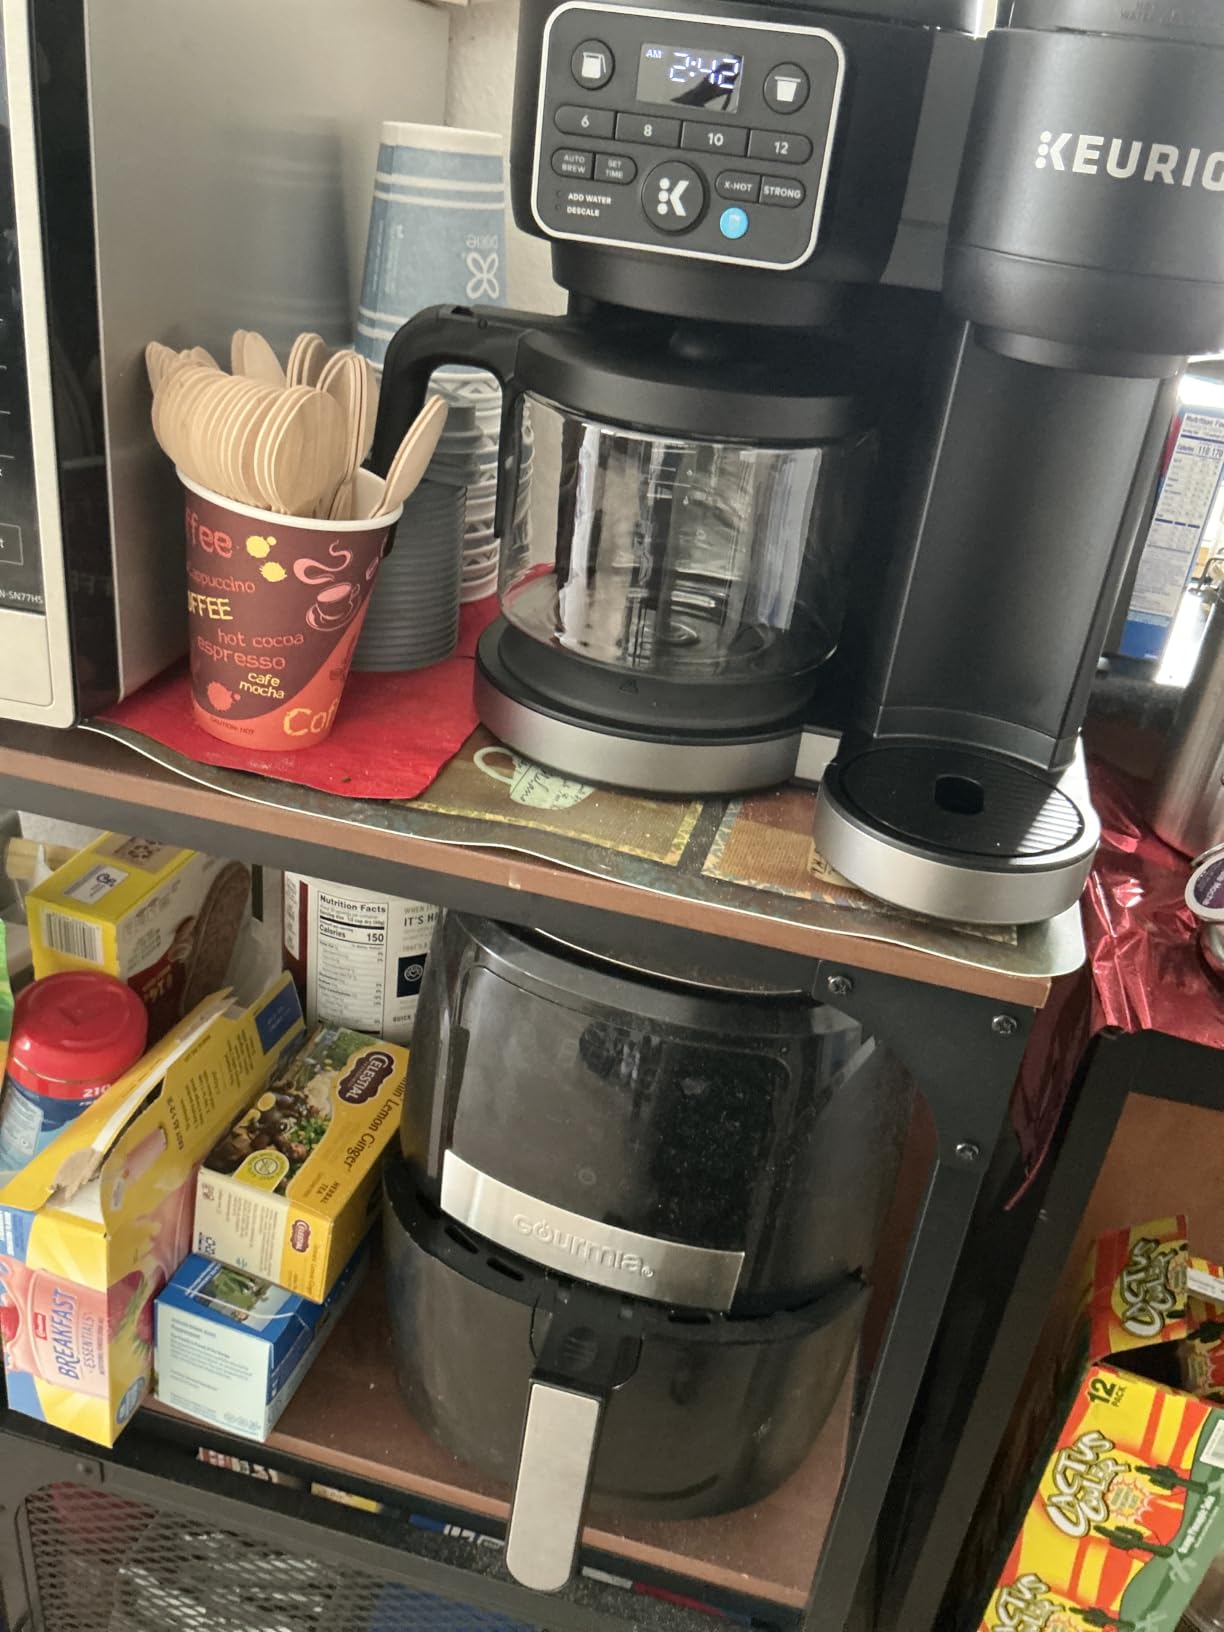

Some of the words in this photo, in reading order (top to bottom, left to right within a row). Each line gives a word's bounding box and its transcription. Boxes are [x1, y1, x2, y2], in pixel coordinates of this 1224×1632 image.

[645, 48, 662, 59] AM
[669, 52, 740, 89] 2:42
[580, 115, 590, 128] 6
[643, 124, 653, 137] 8
[707, 132, 724, 146] 10
[774, 142, 789, 155] 12
[564, 154, 585, 164] AUTO
[607, 159, 622, 168] SET
[561, 164, 586, 174] BREW
[606, 169, 623, 179] TIME
[724, 180, 753, 193] X-HOT
[763, 185, 801, 200] STRONG
[568, 192, 584, 201] ADD
[585, 194, 612, 205] WATER
[566, 206, 600, 217] DESCALE
[218, 628, 249, 648] hot
[252, 632, 305, 648] cocoa
[197, 636, 286, 670] espresso
[248, 671, 280, 687] cafe
[239, 681, 285, 699] mocha
[320, 895, 358, 912] Nutrition
[360, 904, 386, 914] Facts
[404, 915, 424, 927] IT'S
[319, 924, 346, 938] Calories
[366, 932, 385, 943] 150
[345, 1054, 388, 1100] CELESTIAL
[368, 1091, 400, 1137] Lemon
[344, 1132, 376, 1170] Ginger
[1122, 1236, 1164, 1339] CACTUS
[52, 1287, 81, 1381] BREAKFAST
[83, 1313, 97, 1370] ESSENTIALS
[1089, 1376, 1118, 1405] 12
[1111, 1385, 1128, 1408] PACK
[1045, 1430, 1115, 1538] CACTUS
